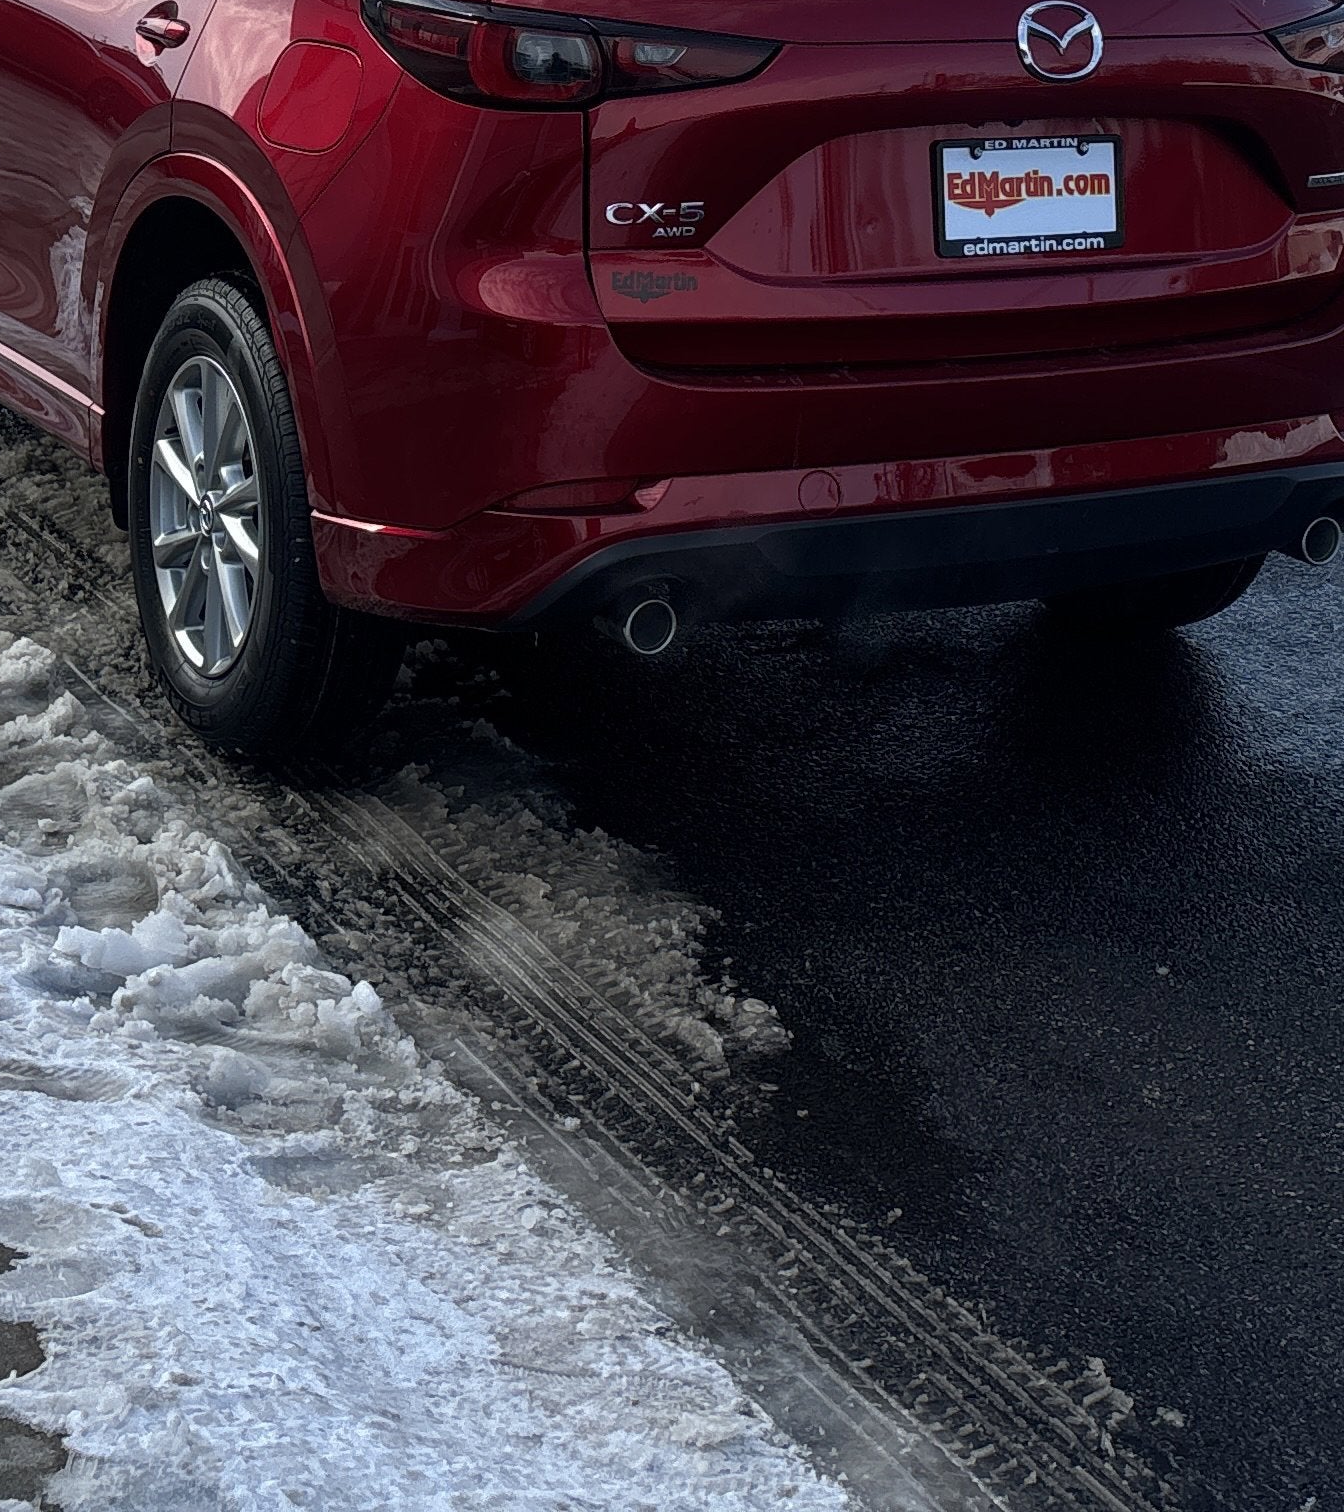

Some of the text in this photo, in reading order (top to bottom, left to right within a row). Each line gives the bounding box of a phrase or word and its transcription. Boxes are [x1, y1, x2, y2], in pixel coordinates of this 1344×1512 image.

[984, 138, 1078, 150] ED MARTIN
[605, 201, 705, 225] CX-5
[652, 226, 696, 238] AWD
[963, 237, 1105, 257] edmartin.com
[610, 271, 699, 292] EdMartin
